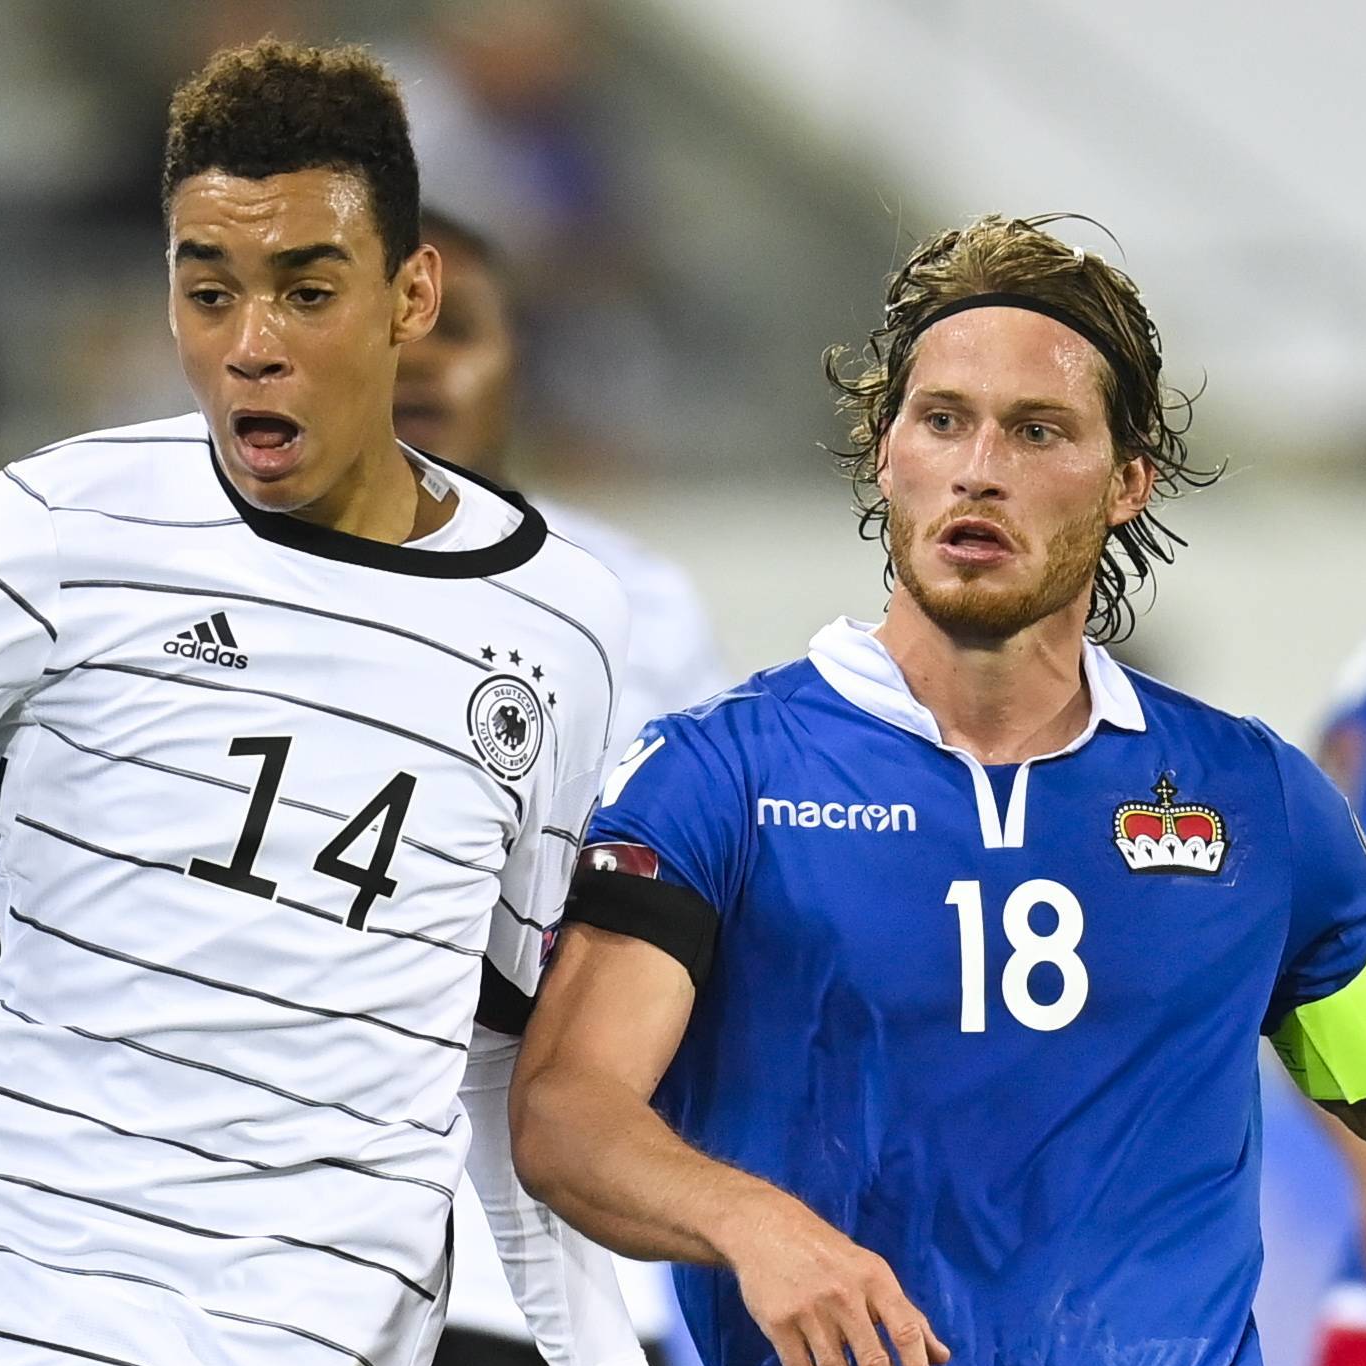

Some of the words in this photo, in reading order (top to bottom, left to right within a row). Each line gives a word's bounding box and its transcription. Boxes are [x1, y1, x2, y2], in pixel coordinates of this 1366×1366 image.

[163, 640, 249, 670] adidas
[494, 688, 537, 722] DEUTSCHER
[757, 798, 917, 832] macron
[188, 736, 417, 931] 14
[944, 878, 1089, 1032] 18
